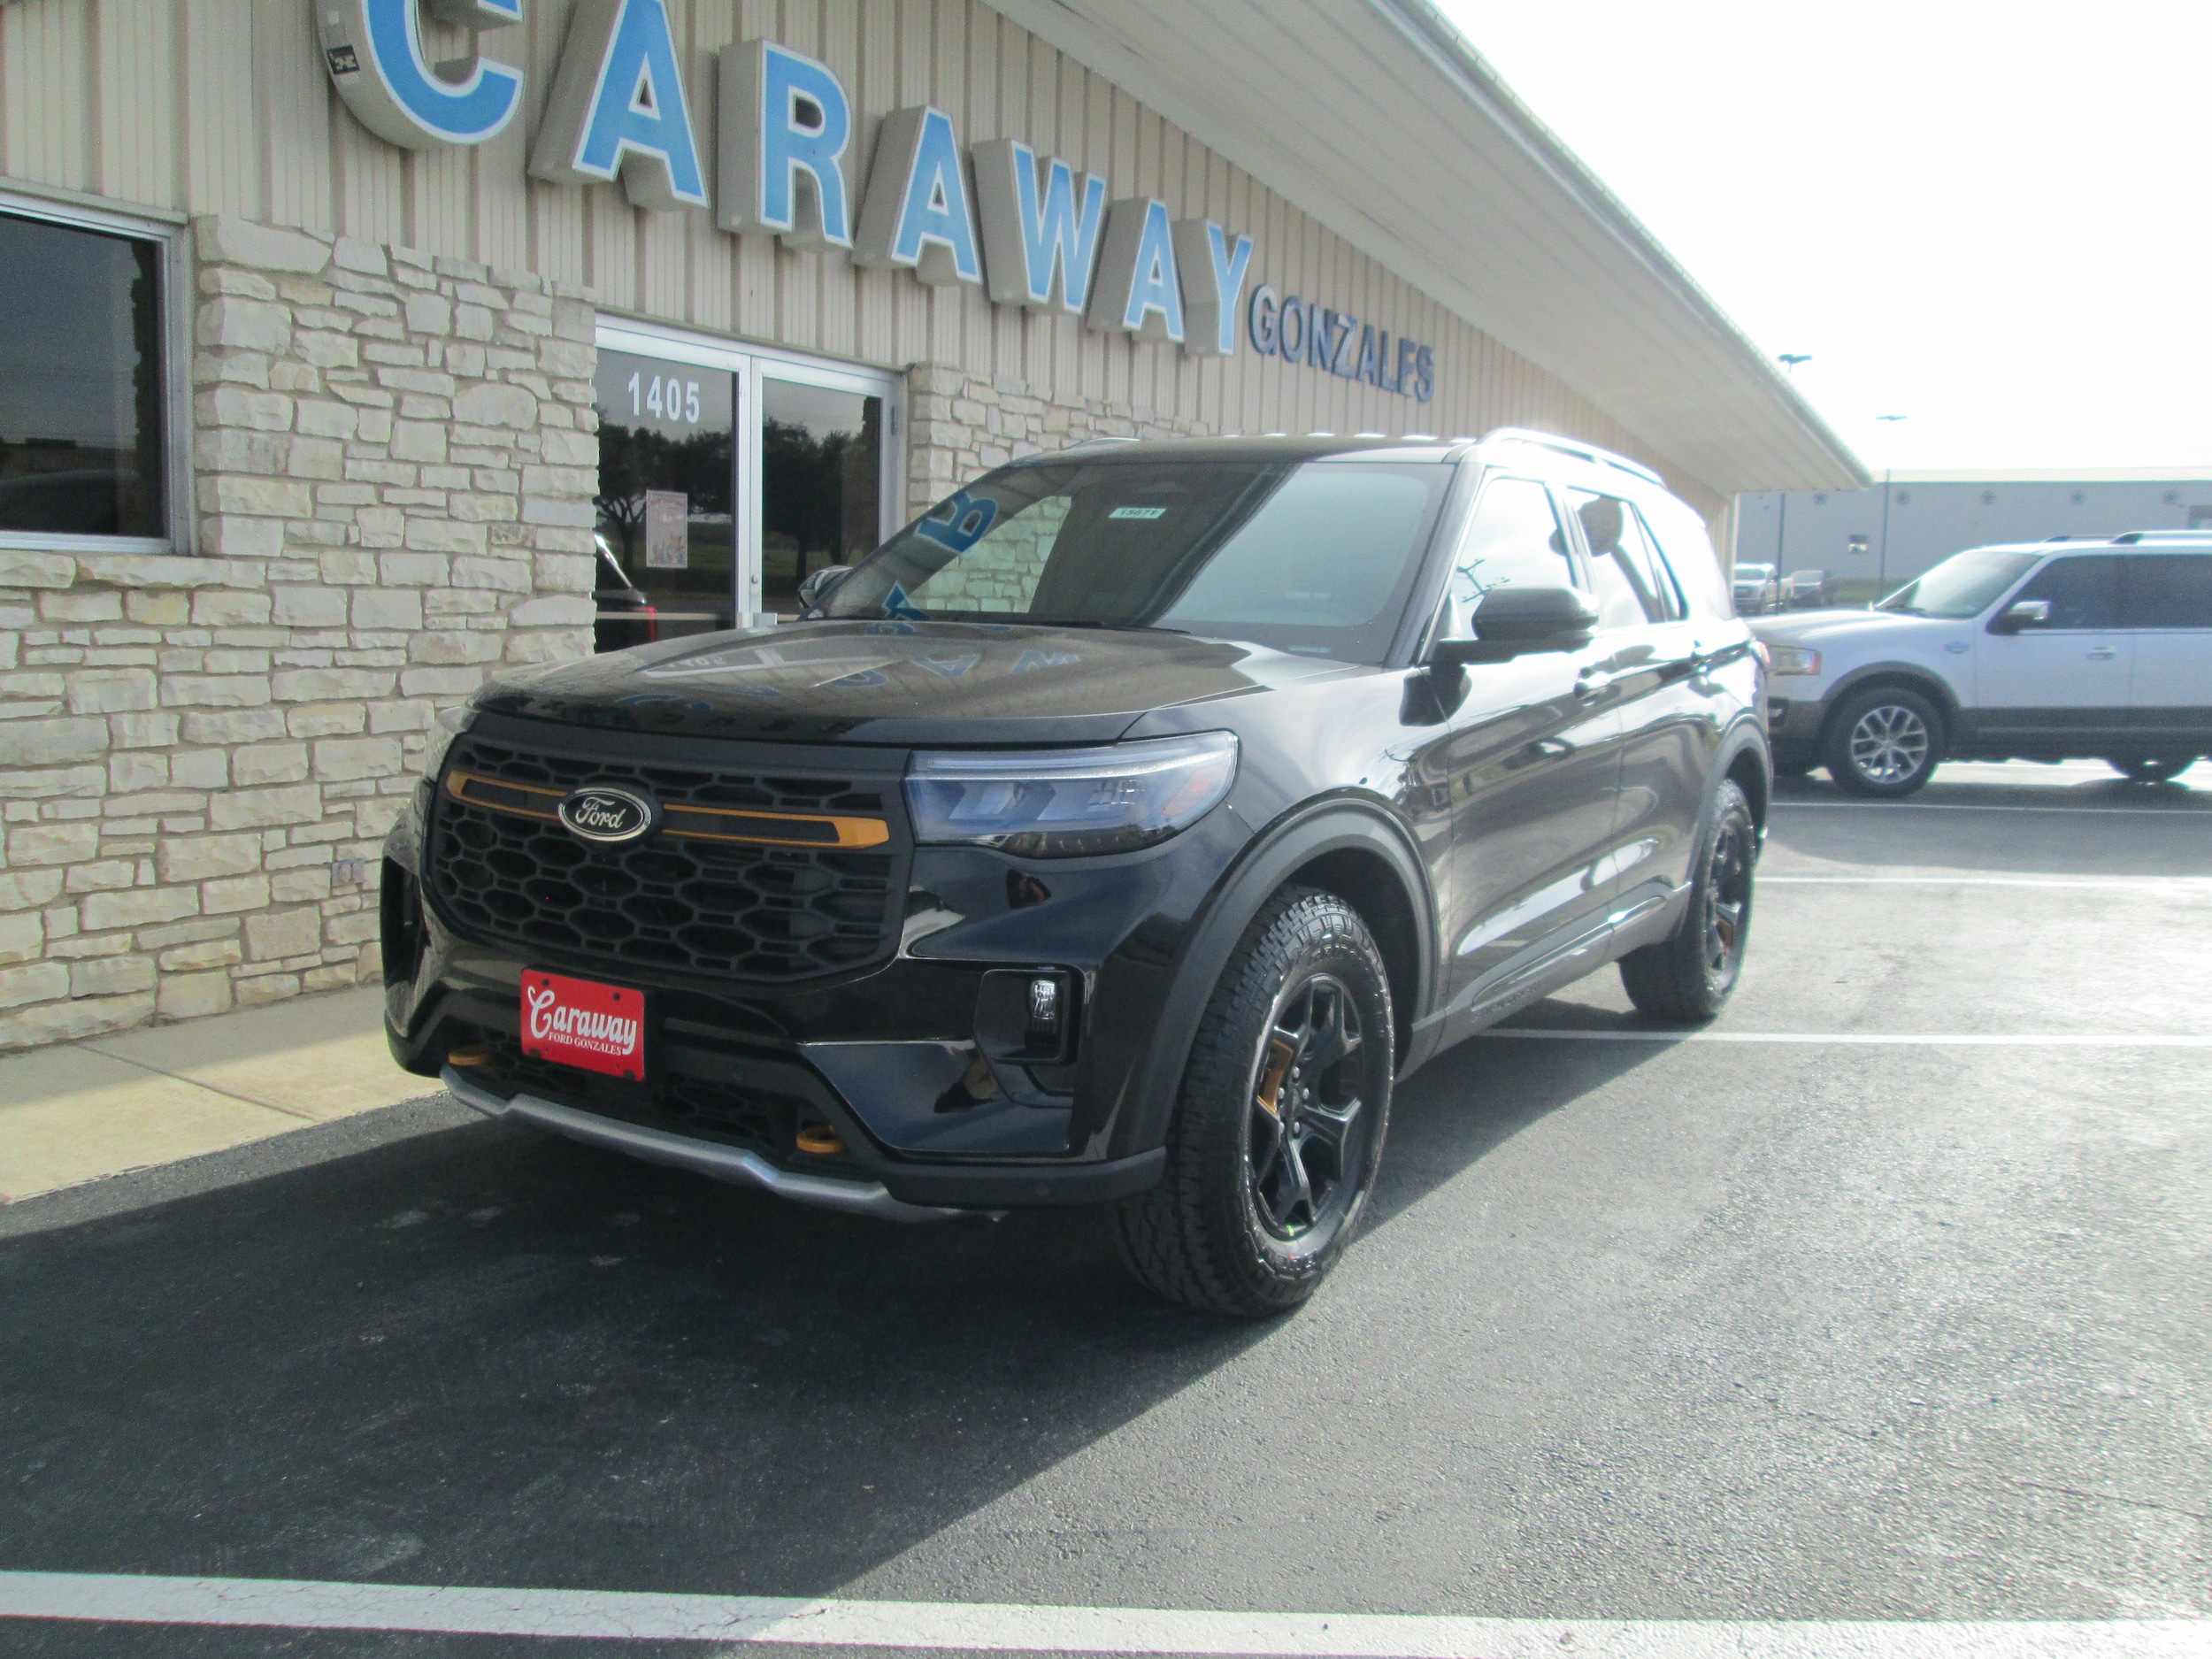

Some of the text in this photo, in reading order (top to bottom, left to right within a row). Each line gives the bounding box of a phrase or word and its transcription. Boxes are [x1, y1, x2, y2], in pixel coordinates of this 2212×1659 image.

[361, 0, 1255, 356] CARAWAY
[1248, 283, 1435, 403] GONZALES
[627, 372, 700, 424] 1405
[575, 796, 627, 829] Ford
[527, 986, 637, 1056] Caraway
[549, 1032, 623, 1056] FORD GONZALES
